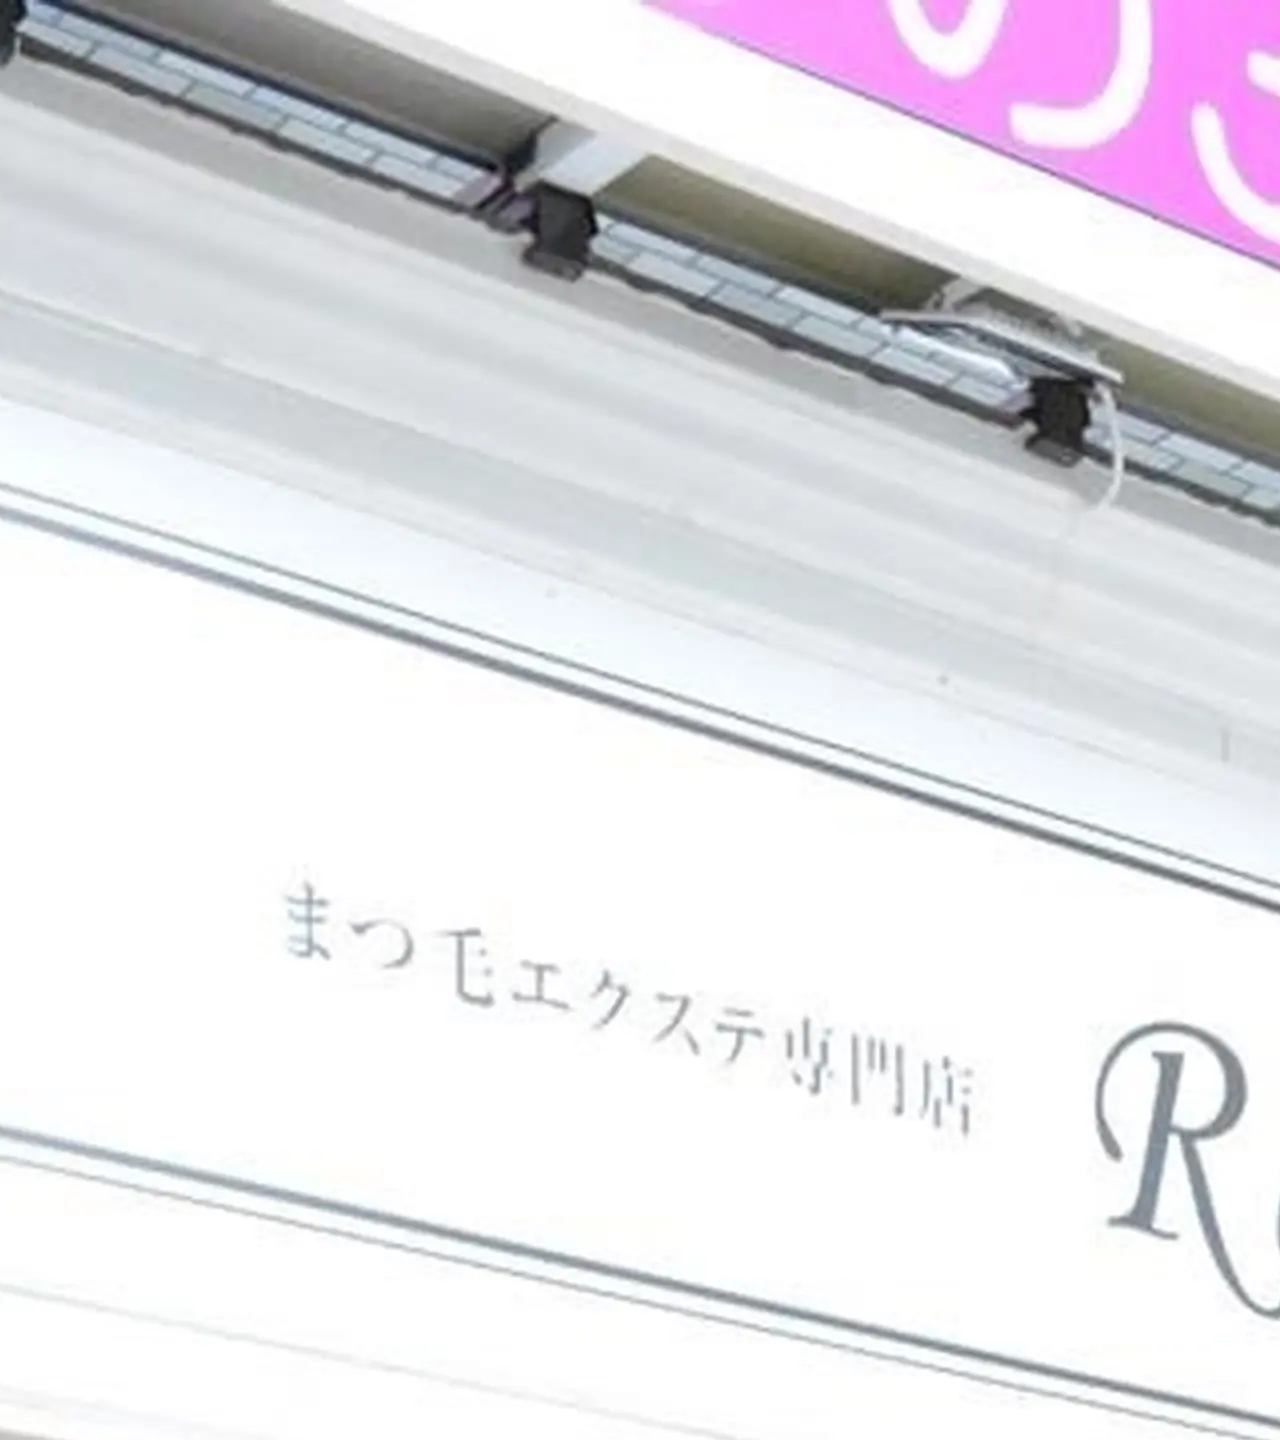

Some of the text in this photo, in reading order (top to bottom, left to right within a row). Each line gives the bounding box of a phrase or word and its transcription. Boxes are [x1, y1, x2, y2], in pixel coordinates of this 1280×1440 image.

[285, 881, 975, 1137] まつ毛エクステ専門店
